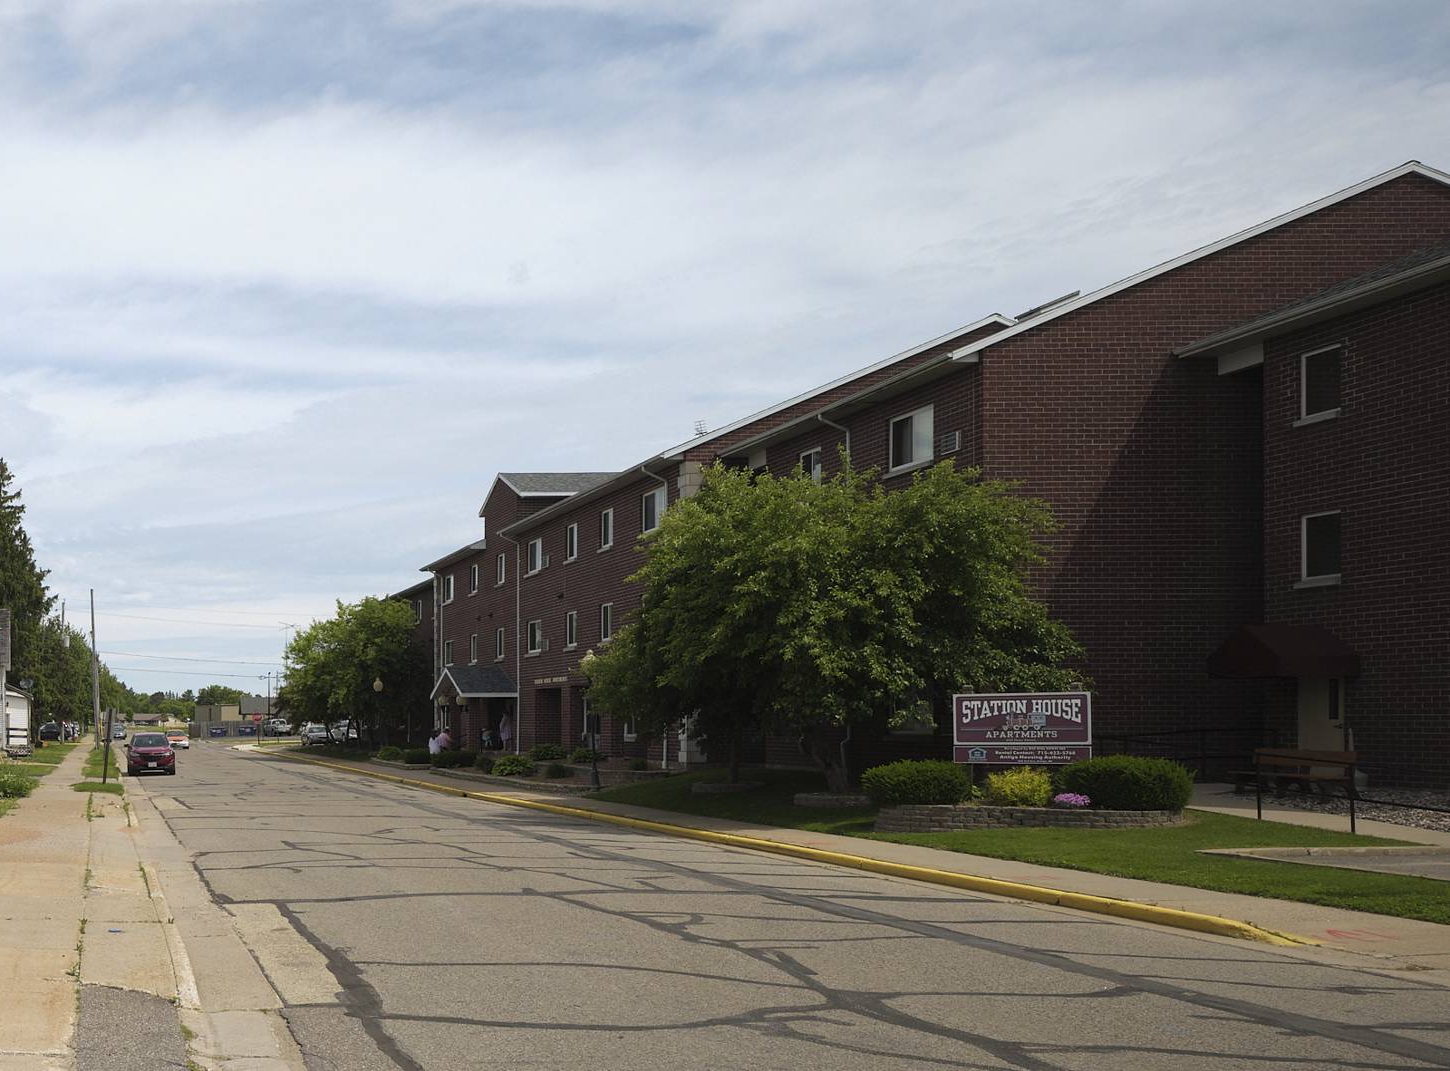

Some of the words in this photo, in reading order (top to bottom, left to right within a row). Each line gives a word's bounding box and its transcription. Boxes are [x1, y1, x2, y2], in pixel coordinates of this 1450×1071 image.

[962, 699, 1027, 723] STATION
[1032, 699, 1081, 723] HOUSE
[985, 730, 1058, 739] APARTMENTS
